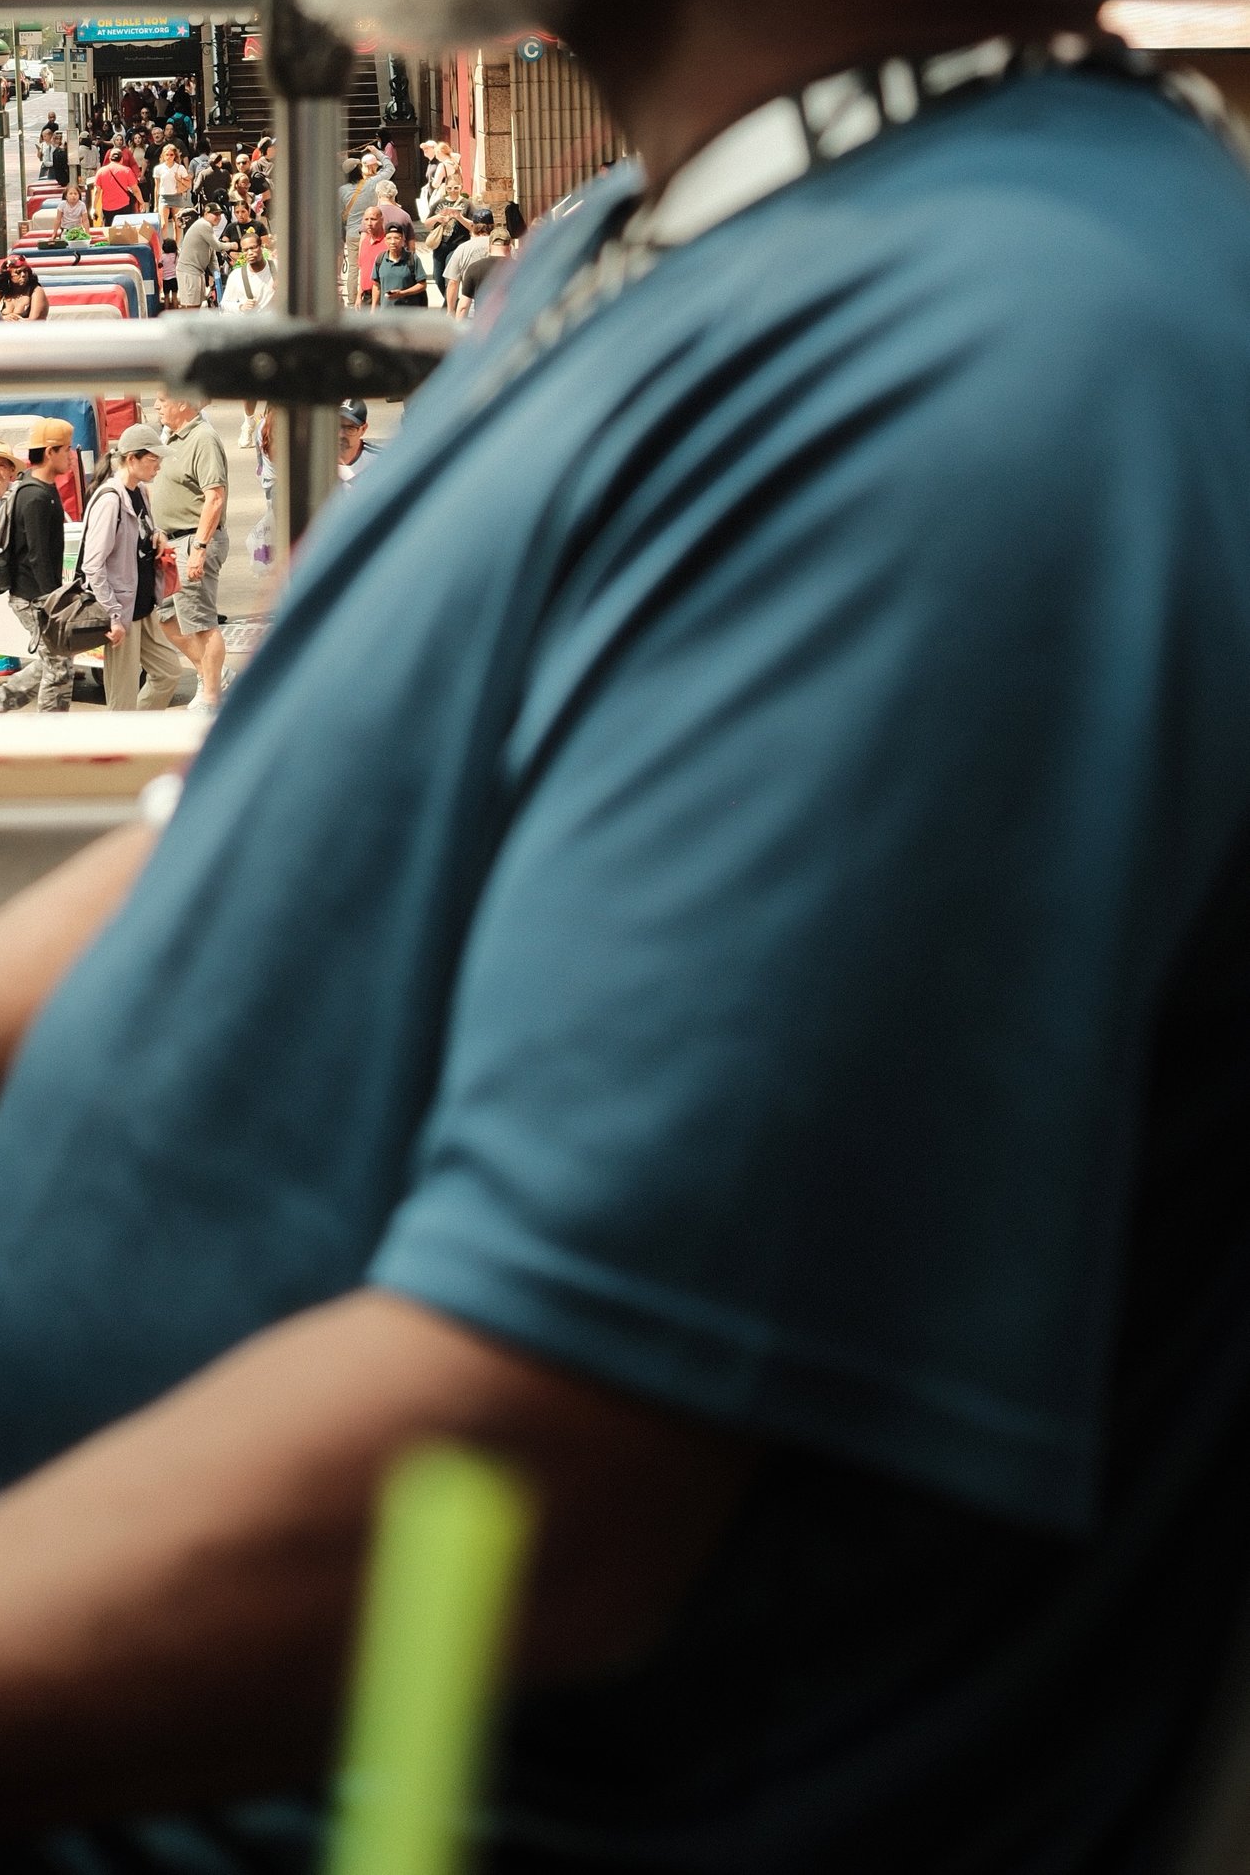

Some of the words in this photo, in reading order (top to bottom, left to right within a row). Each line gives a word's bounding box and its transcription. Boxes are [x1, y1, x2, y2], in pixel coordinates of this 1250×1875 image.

[116, 16, 140, 26] SALE
[143, 15, 168, 25] NOW
[107, 26, 170, 36] NEWVICTORY.ORG
[523, 41, 540, 59] C
